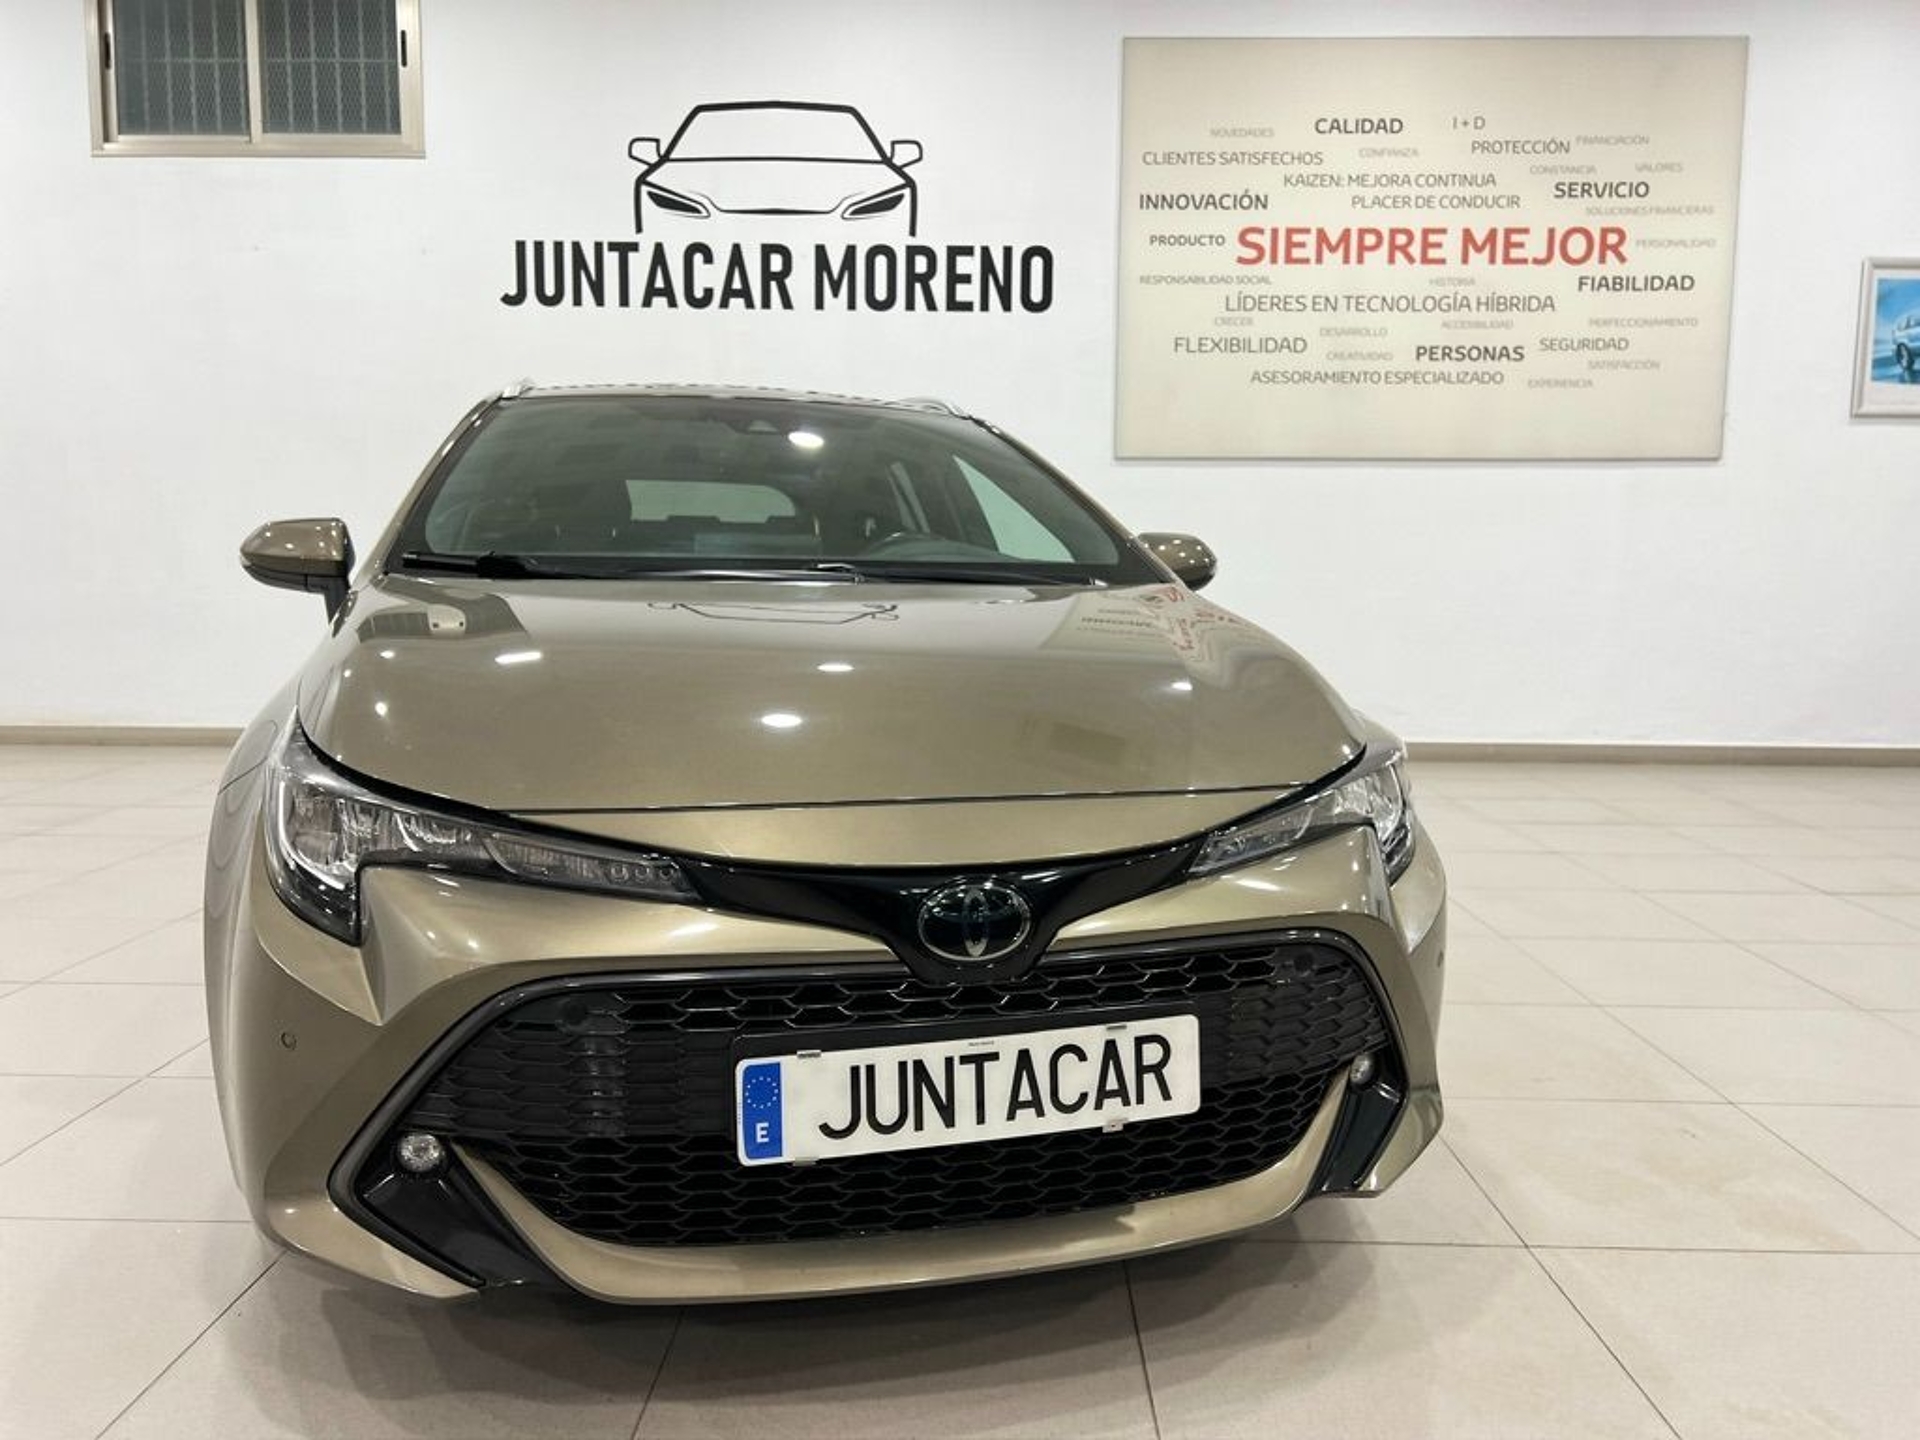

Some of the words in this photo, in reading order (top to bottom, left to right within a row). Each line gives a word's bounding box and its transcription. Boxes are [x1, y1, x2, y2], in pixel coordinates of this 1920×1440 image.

[1315, 117, 1403, 135] CALIDAD
[1474, 117, 1485, 130] D
[1210, 127, 1274, 138] NOVEDADES
[1359, 147, 1418, 158] CONFIANZA
[1472, 138, 1570, 154] PROTECCIÓN
[1143, 152, 1215, 166] CLIENTES
[1219, 152, 1323, 166] SATISFECHOS
[1530, 164, 1596, 175] CONSTANCIA
[1635, 162, 1684, 173] VALORES
[1284, 173, 1343, 188] KAIZEN:
[1348, 173, 1410, 188] MEJORA
[1415, 173, 1497, 188] CONTINUA
[1554, 181, 1650, 199] SERVICIO
[1139, 190, 1268, 211] INNOVACIÓN
[1352, 195, 1411, 209] PLACER
[1415, 195, 1435, 209] DE
[1439, 195, 1521, 209] CONDUCIR
[1586, 205, 1648, 216] SOLUCIONES
[1649, 205, 1714, 216] FINANCIERAS
[1150, 234, 1226, 247] PRODUCTO
[1236, 226, 1448, 266] SIEMPRE
[1461, 226, 1628, 266] MEJOR
[1635, 238, 1717, 249] PERSONALIDAD
[500, 240, 794, 309] JUNTACAR
[813, 243, 1055, 314] MORENO
[1139, 275, 1234, 286] RESPONSABILIDAD
[1236, 275, 1272, 286] SOCIAL
[1429, 276, 1476, 287] HISTORIA
[1578, 275, 1695, 292] FIABILIDAD
[1224, 290, 1308, 313] LÍDERES
[1312, 295, 1338, 313] EN
[1342, 290, 1472, 313] TECNOLOGÍA
[1475, 290, 1556, 313] HÍBRIDA
[1214, 316, 1254, 327] CRECER
[1319, 326, 1388, 337] DESARROLLO
[1173, 337, 1308, 354] FLEXIBILIDAD
[1539, 337, 1630, 352] SEGURIDAD
[1325, 351, 1393, 361] CREATIVIDAD
[1415, 345, 1526, 363] PERSONAS
[1250, 370, 1381, 385] ASESORAMIENTO
[1384, 370, 1504, 385] ESPECIALIZADO
[818, 1033, 1173, 1140] JUNTACAR
[755, 1122, 770, 1143] E
